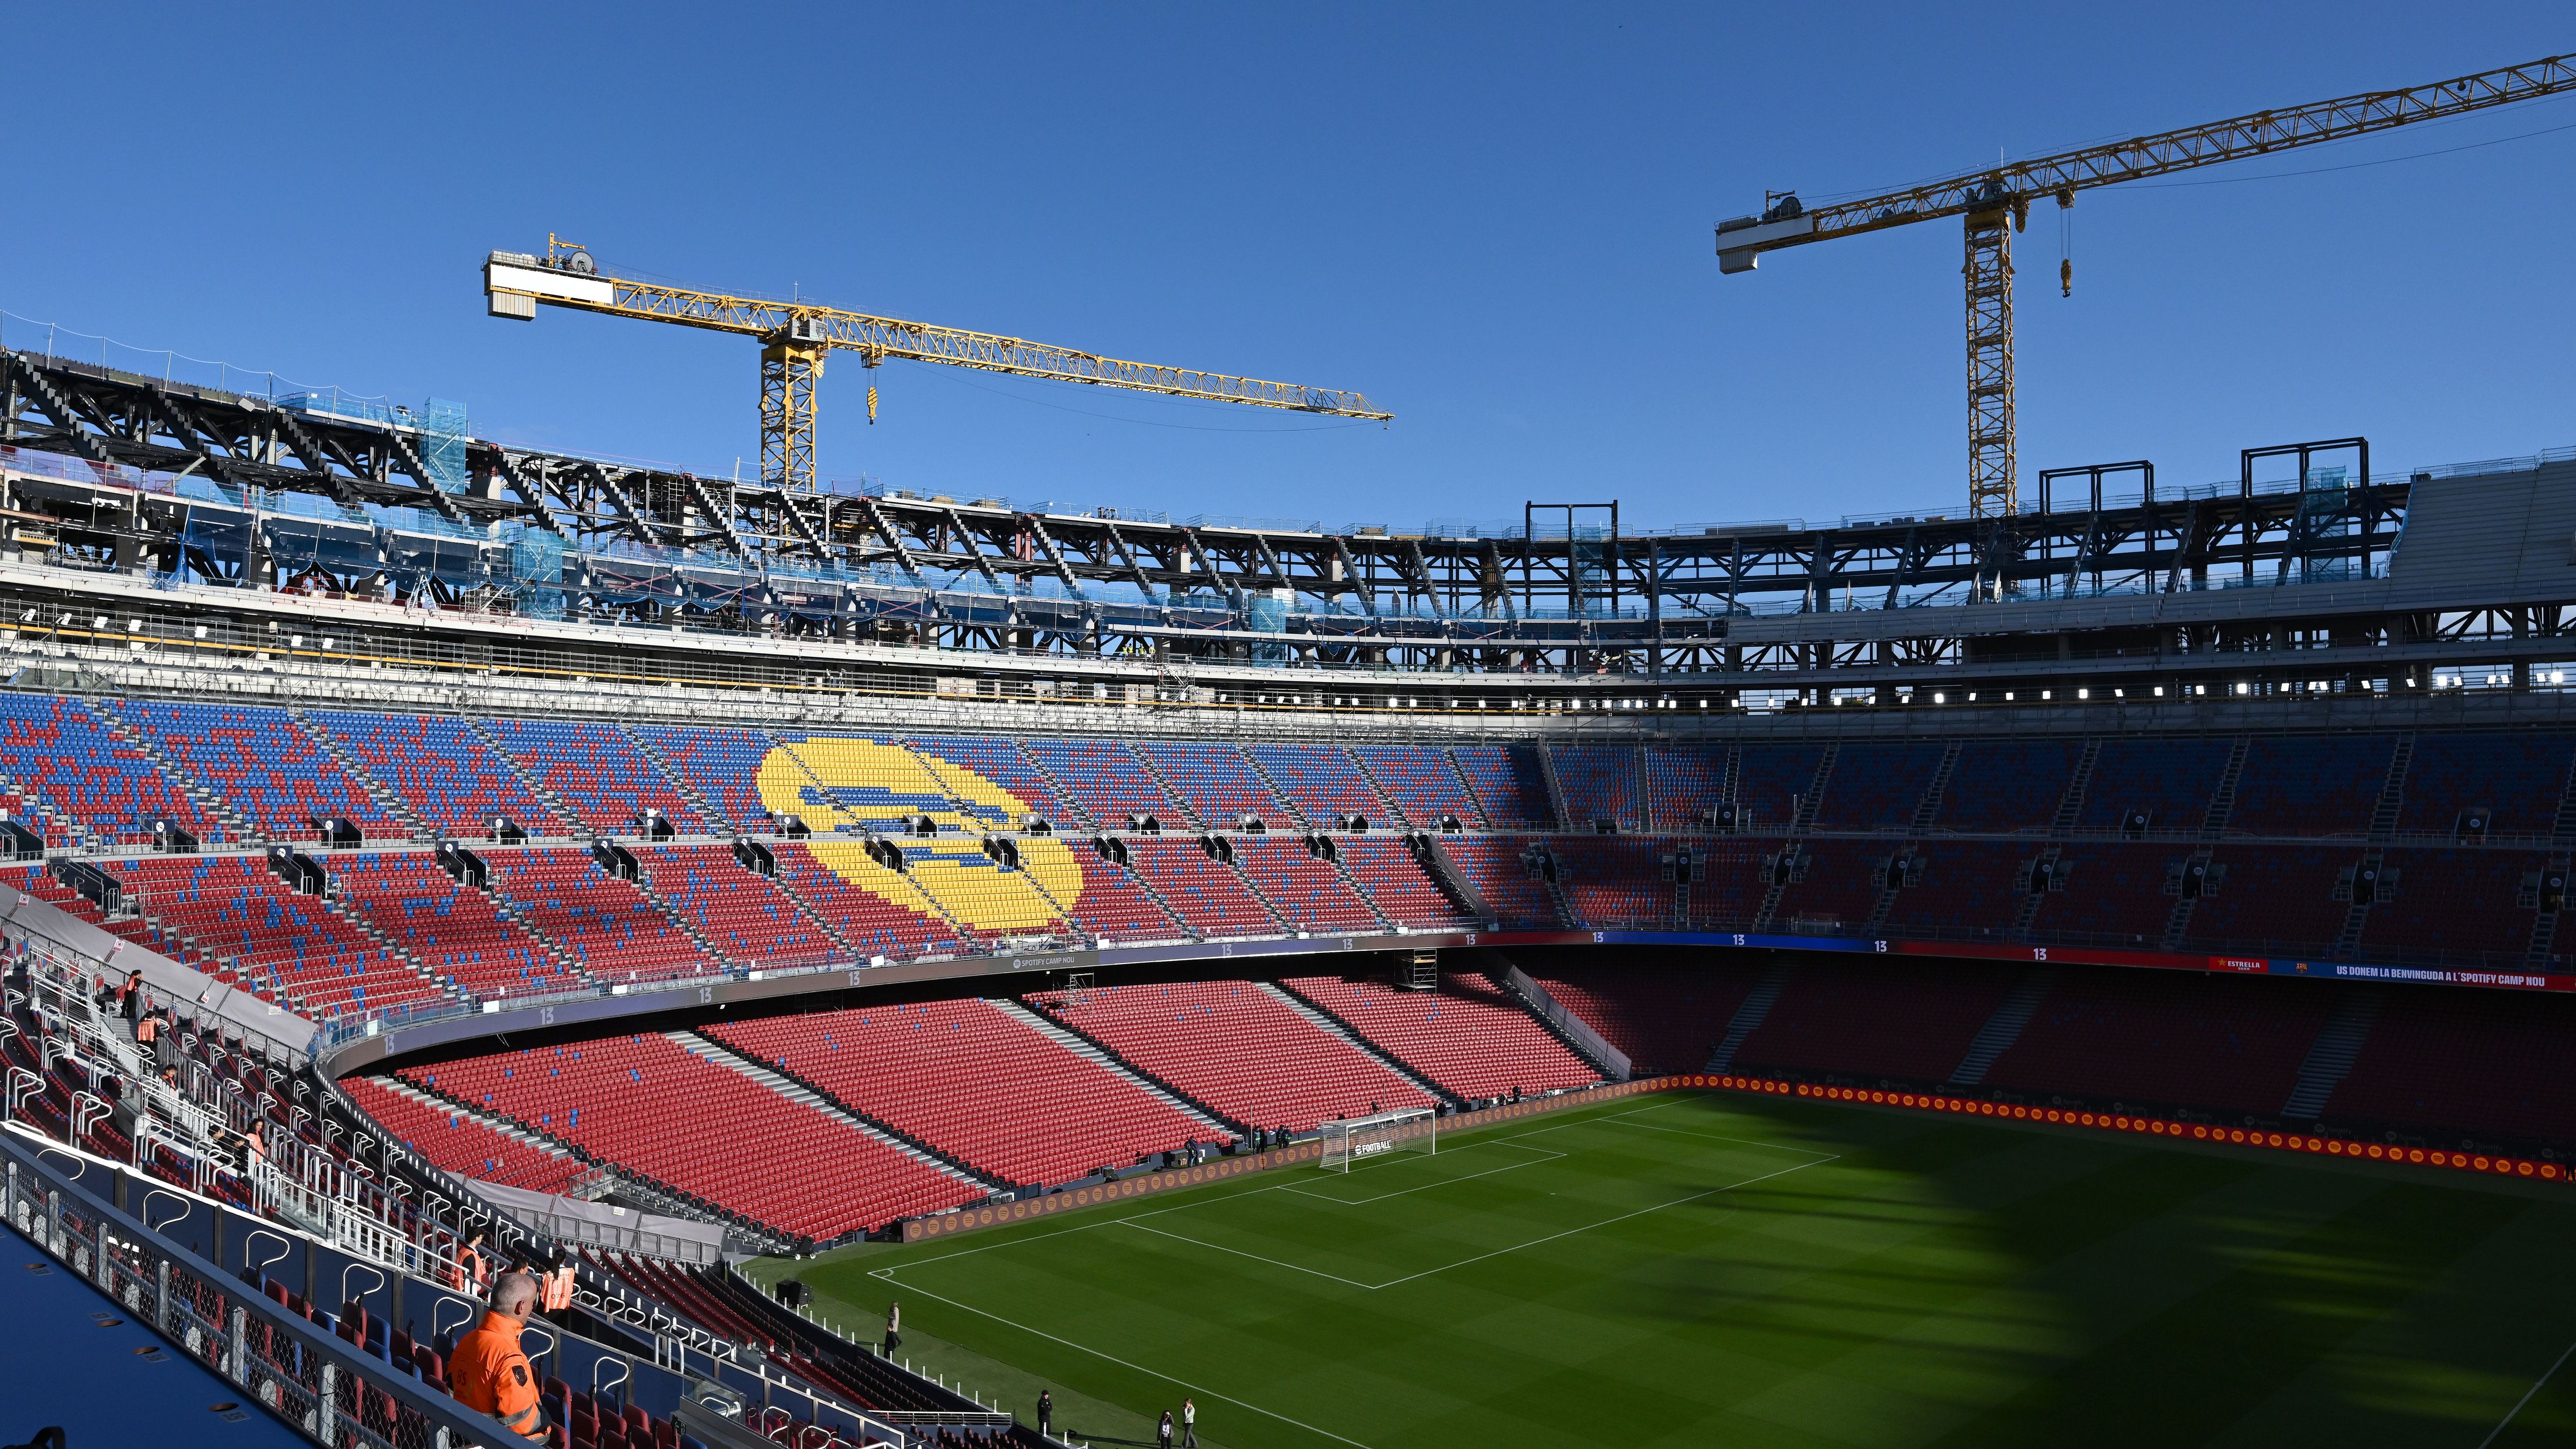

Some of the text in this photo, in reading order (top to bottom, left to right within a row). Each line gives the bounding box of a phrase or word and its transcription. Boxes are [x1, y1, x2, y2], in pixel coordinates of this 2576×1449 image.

[1466, 934, 1476, 945] 13
[1592, 932, 1604, 943] 13
[1733, 934, 1745, 946] 13
[1222, 944, 1232, 956] 13
[1343, 938, 1353, 950] 13
[1875, 940, 1887, 952] 13
[2034, 948, 2047, 961] 13
[1022, 958, 1045, 967] SPOTIFY
[849, 971, 860, 986] 13
[2337, 966, 2347, 975] US
[2349, 967, 2378, 976] DONEM
[2380, 968, 2390, 977] LA
[2391, 969, 2444, 981] BENVINGUDA
[2445, 972, 2451, 981] A
[2498, 975, 2524, 985] CAMP
[2526, 976, 2545, 987] NOU
[700, 987, 712, 1003] 13
[540, 1007, 554, 1025] 13
[384, 1034, 394, 1055] 13
[457, 1368, 468, 1386] BS
